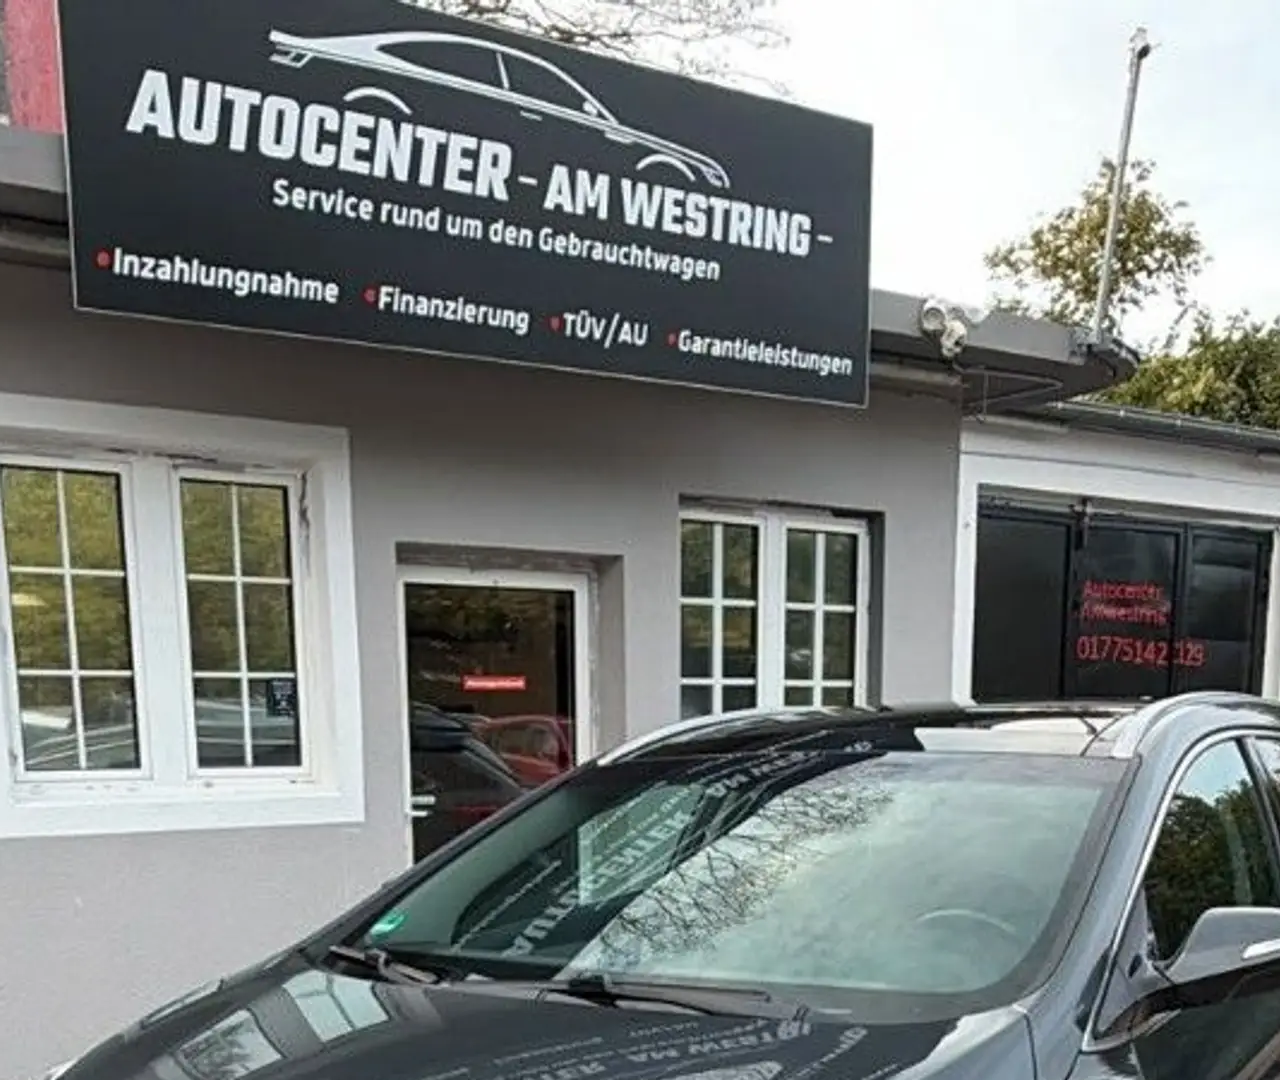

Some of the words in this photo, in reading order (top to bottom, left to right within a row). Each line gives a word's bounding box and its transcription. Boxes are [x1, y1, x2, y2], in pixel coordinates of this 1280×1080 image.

[126, 69, 512, 201] AUTOCENTER
[543, 163, 611, 220] AM
[620, 177, 813, 257] WESTRING
[272, 178, 374, 222] Service
[380, 199, 440, 232] rund
[446, 212, 483, 240] um
[489, 218, 533, 249] den
[538, 228, 721, 281] Gebrauchtwagen
[113, 246, 340, 305] Inzahlungnahme
[377, 285, 531, 335] Finanzierung
[562, 310, 650, 348] TÜV/AU
[677, 328, 853, 377] Garantieleistungen
